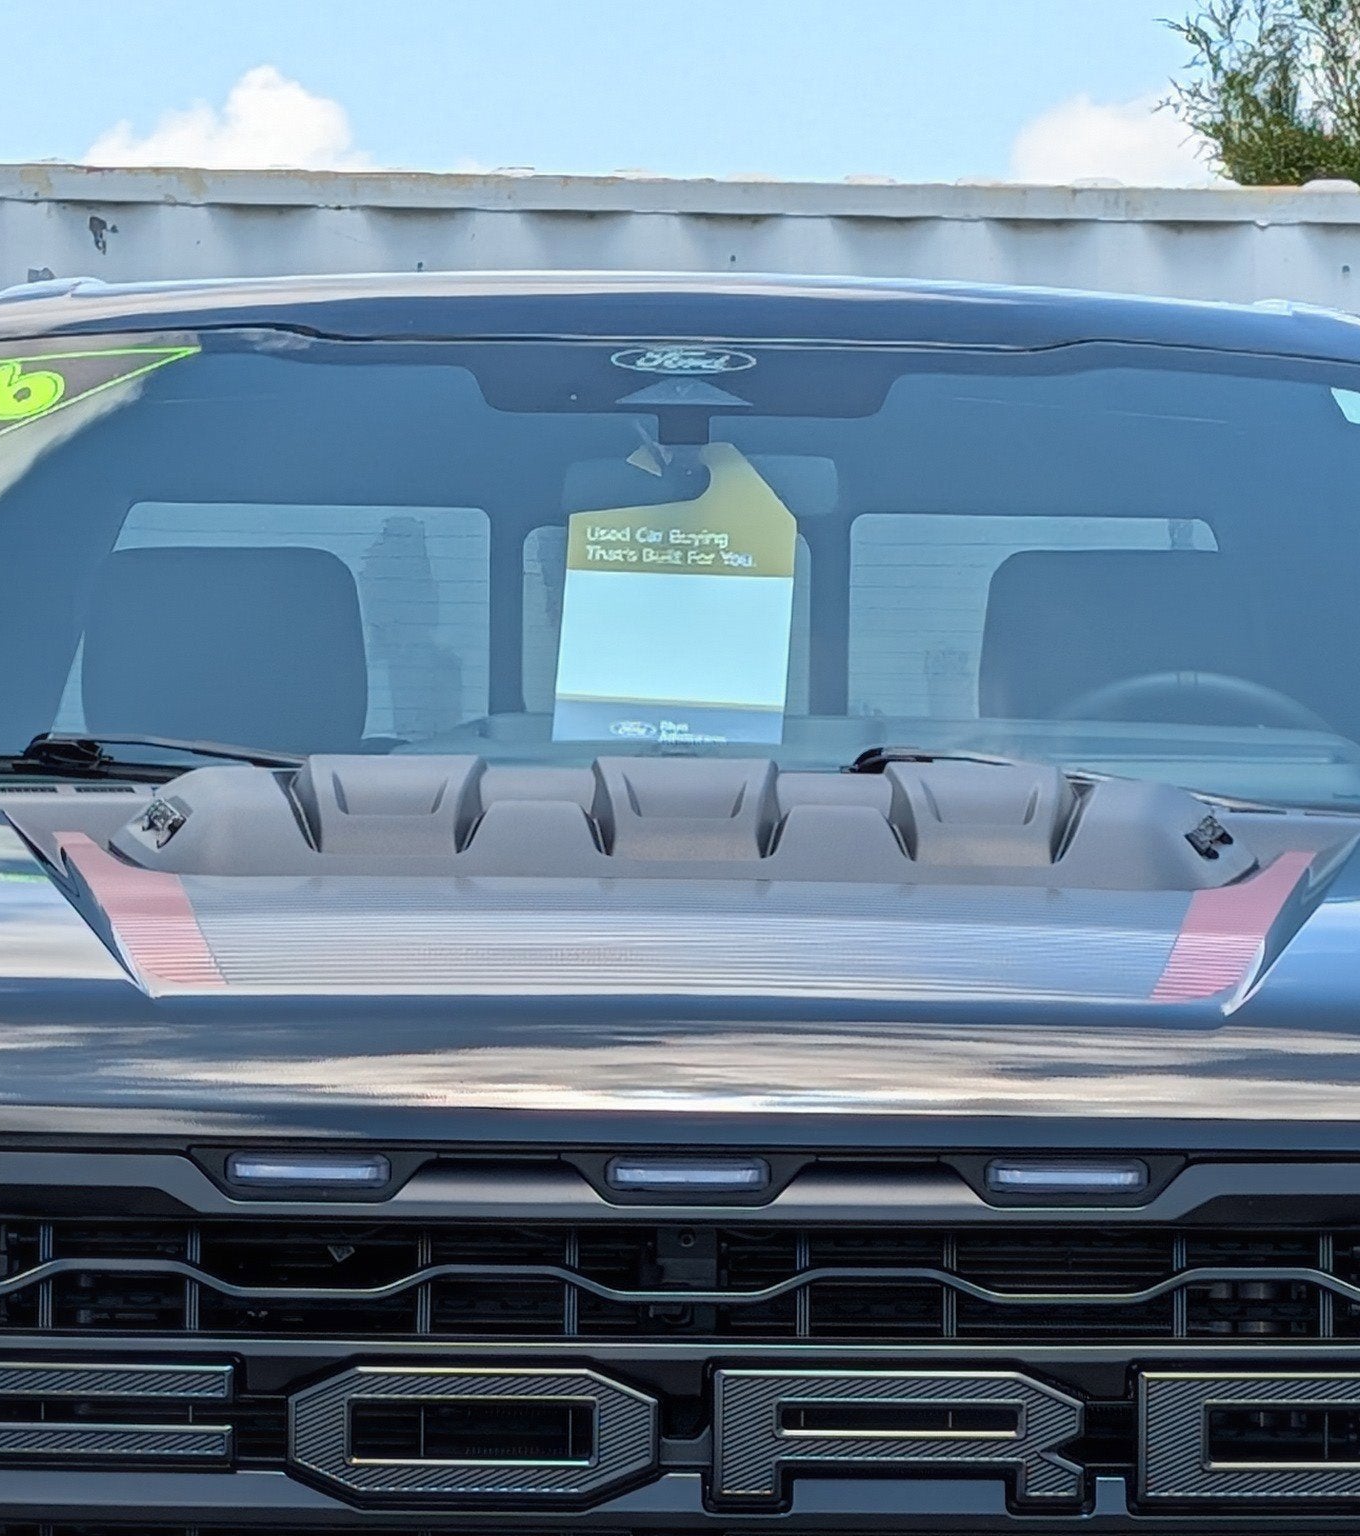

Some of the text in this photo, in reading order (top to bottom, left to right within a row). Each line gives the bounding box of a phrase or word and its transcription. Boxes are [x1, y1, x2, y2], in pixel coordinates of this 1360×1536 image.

[586, 526, 728, 548] Used Car Buying
[586, 545, 637, 563] That's
[642, 548, 683, 565] Built
[687, 551, 715, 565] For
